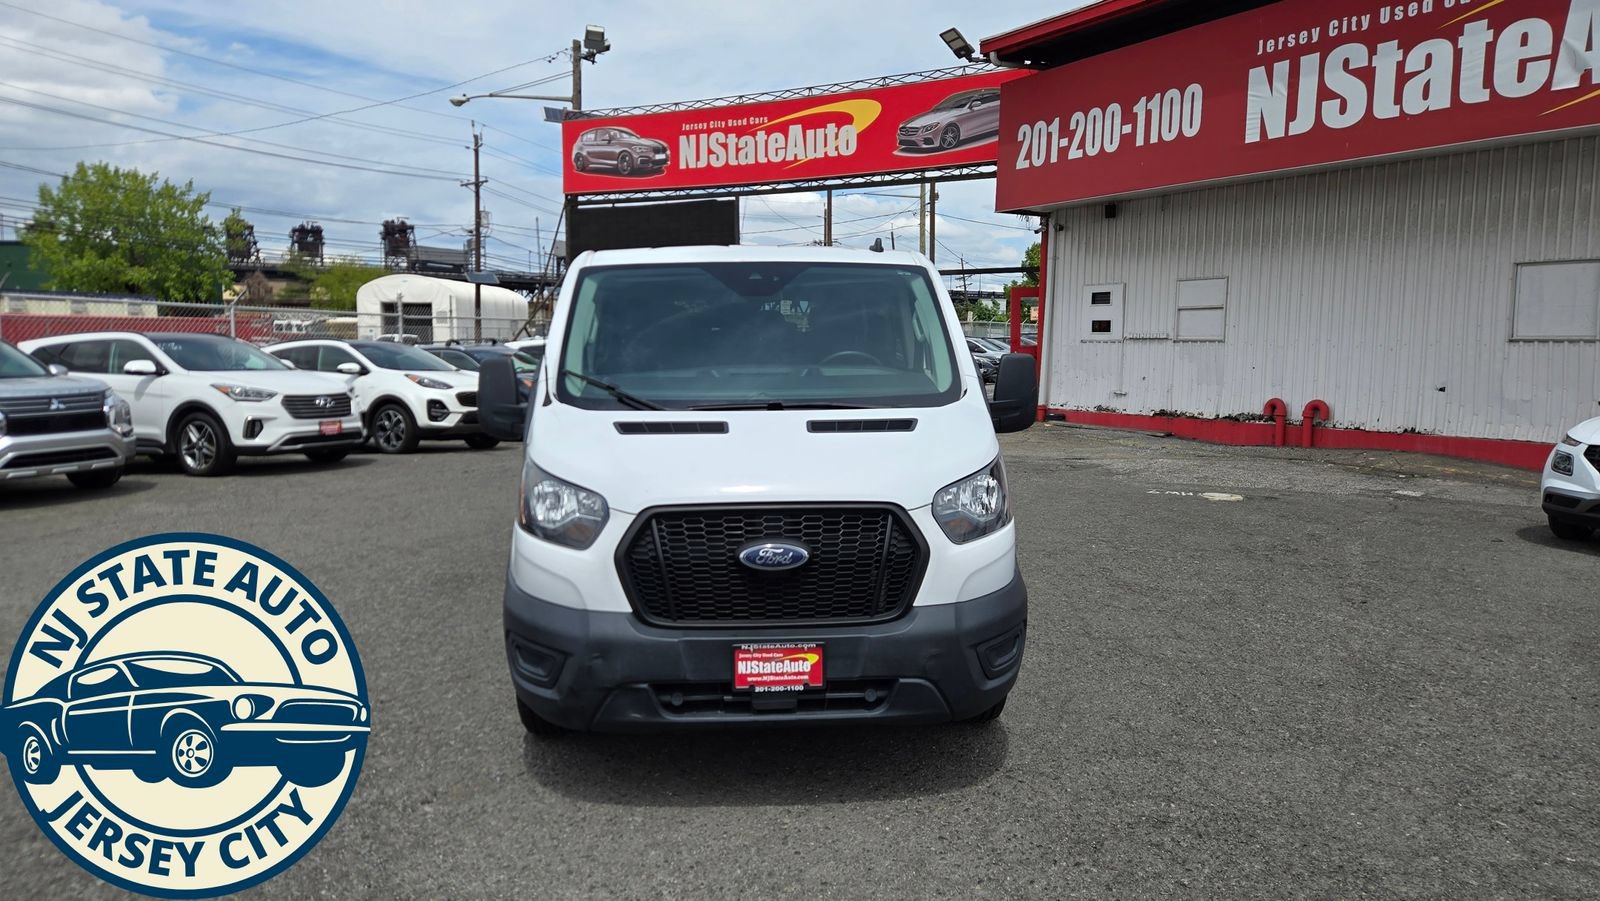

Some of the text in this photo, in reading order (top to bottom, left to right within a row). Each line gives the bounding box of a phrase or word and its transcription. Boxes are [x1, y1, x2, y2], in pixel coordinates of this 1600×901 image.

[1257, 0, 1433, 55] Jersey City Used
[682, 116, 768, 131] Jersey City Used Cars
[1016, 83, 1203, 169] 201-200-1100
[679, 123, 857, 169] NJStateAuto
[755, 548, 793, 565] Ford
[738, 660, 811, 674] NJStateAuto
